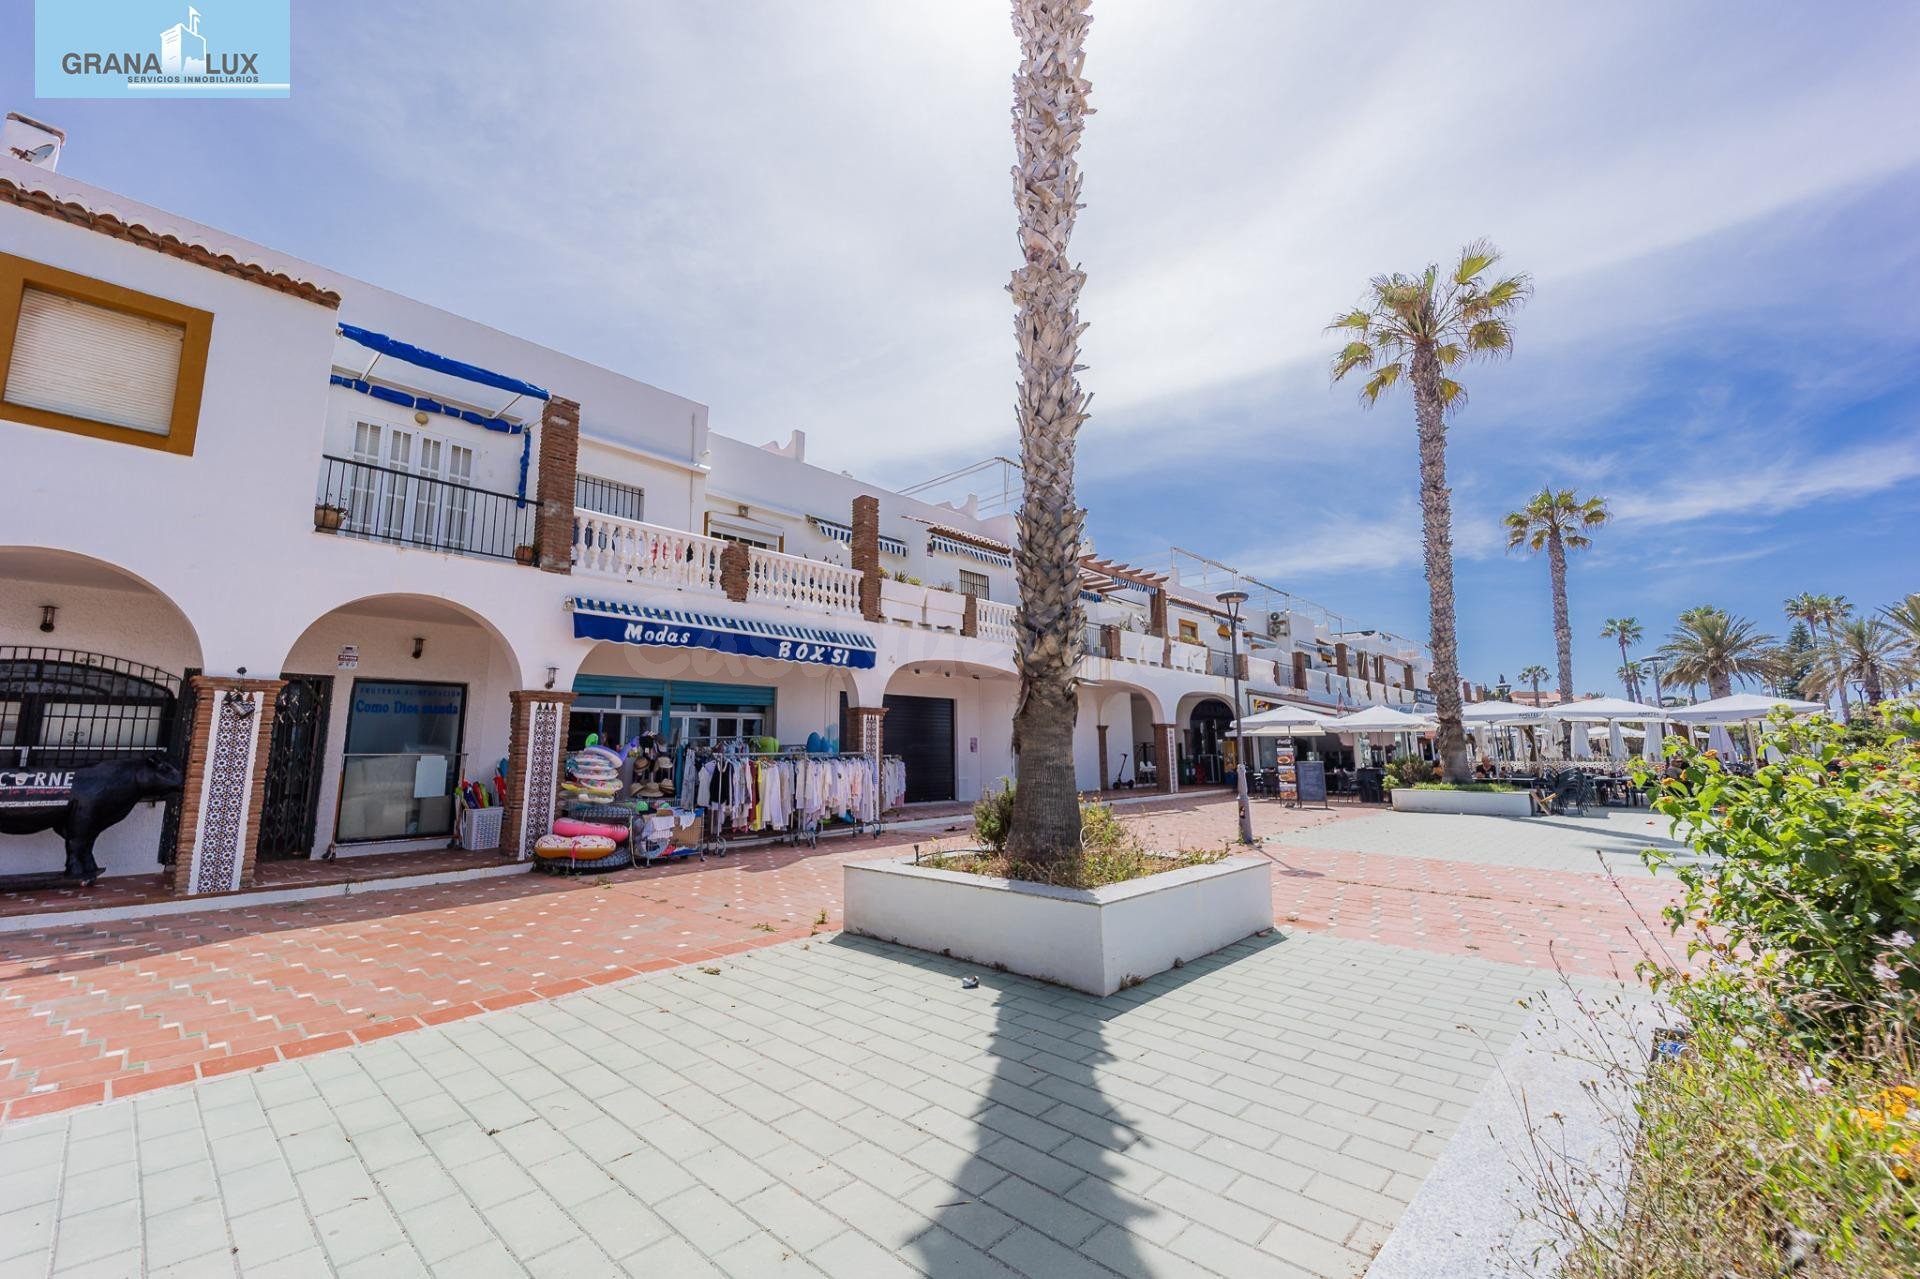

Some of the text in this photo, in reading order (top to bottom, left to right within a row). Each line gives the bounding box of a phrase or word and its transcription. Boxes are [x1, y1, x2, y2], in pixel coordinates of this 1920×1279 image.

[624, 622, 690, 643] Modas
[356, 699, 389, 713] Como
[394, 700, 418, 714] Dios
